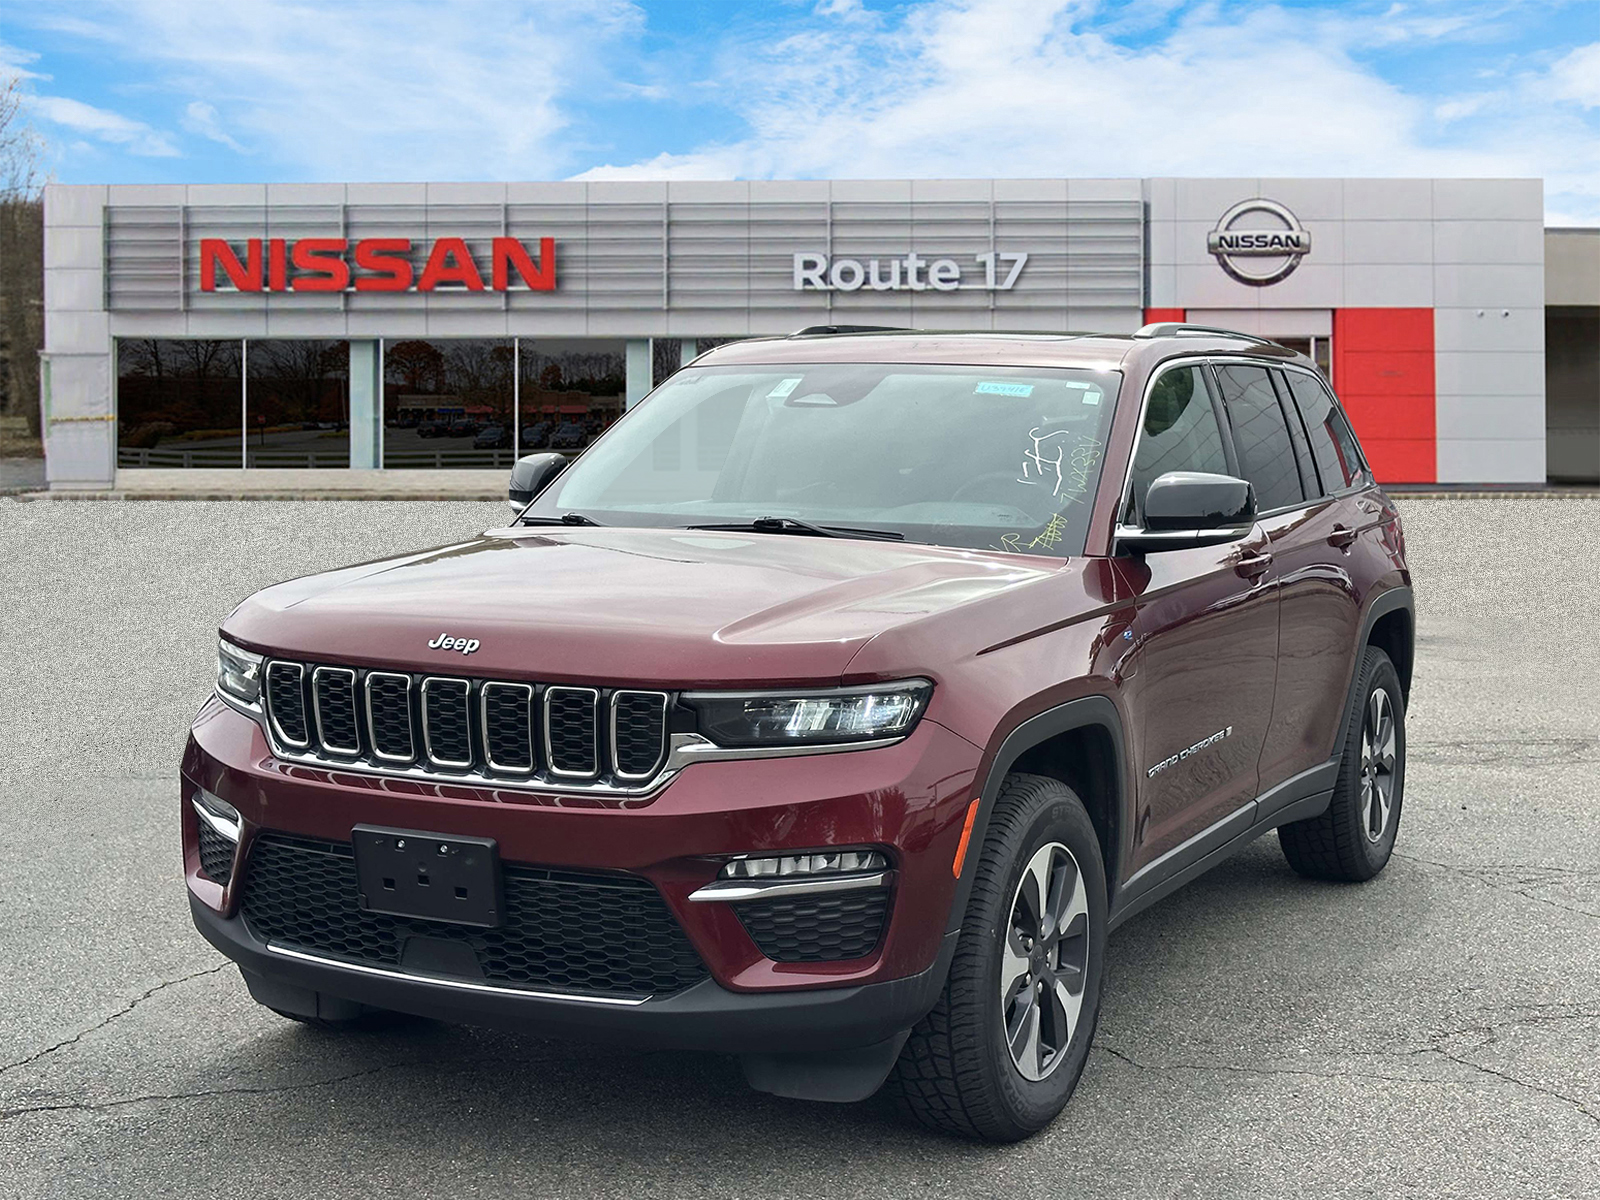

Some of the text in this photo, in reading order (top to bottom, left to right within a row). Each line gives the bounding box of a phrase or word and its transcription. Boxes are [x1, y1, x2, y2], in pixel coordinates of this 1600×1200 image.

[1219, 235, 1300, 249] NISSAN
[200, 237, 555, 292] NISSAN
[793, 251, 1028, 291] Route 17
[427, 632, 481, 655] Jeep
[1147, 729, 1225, 778] GRAND CHEROKEE
